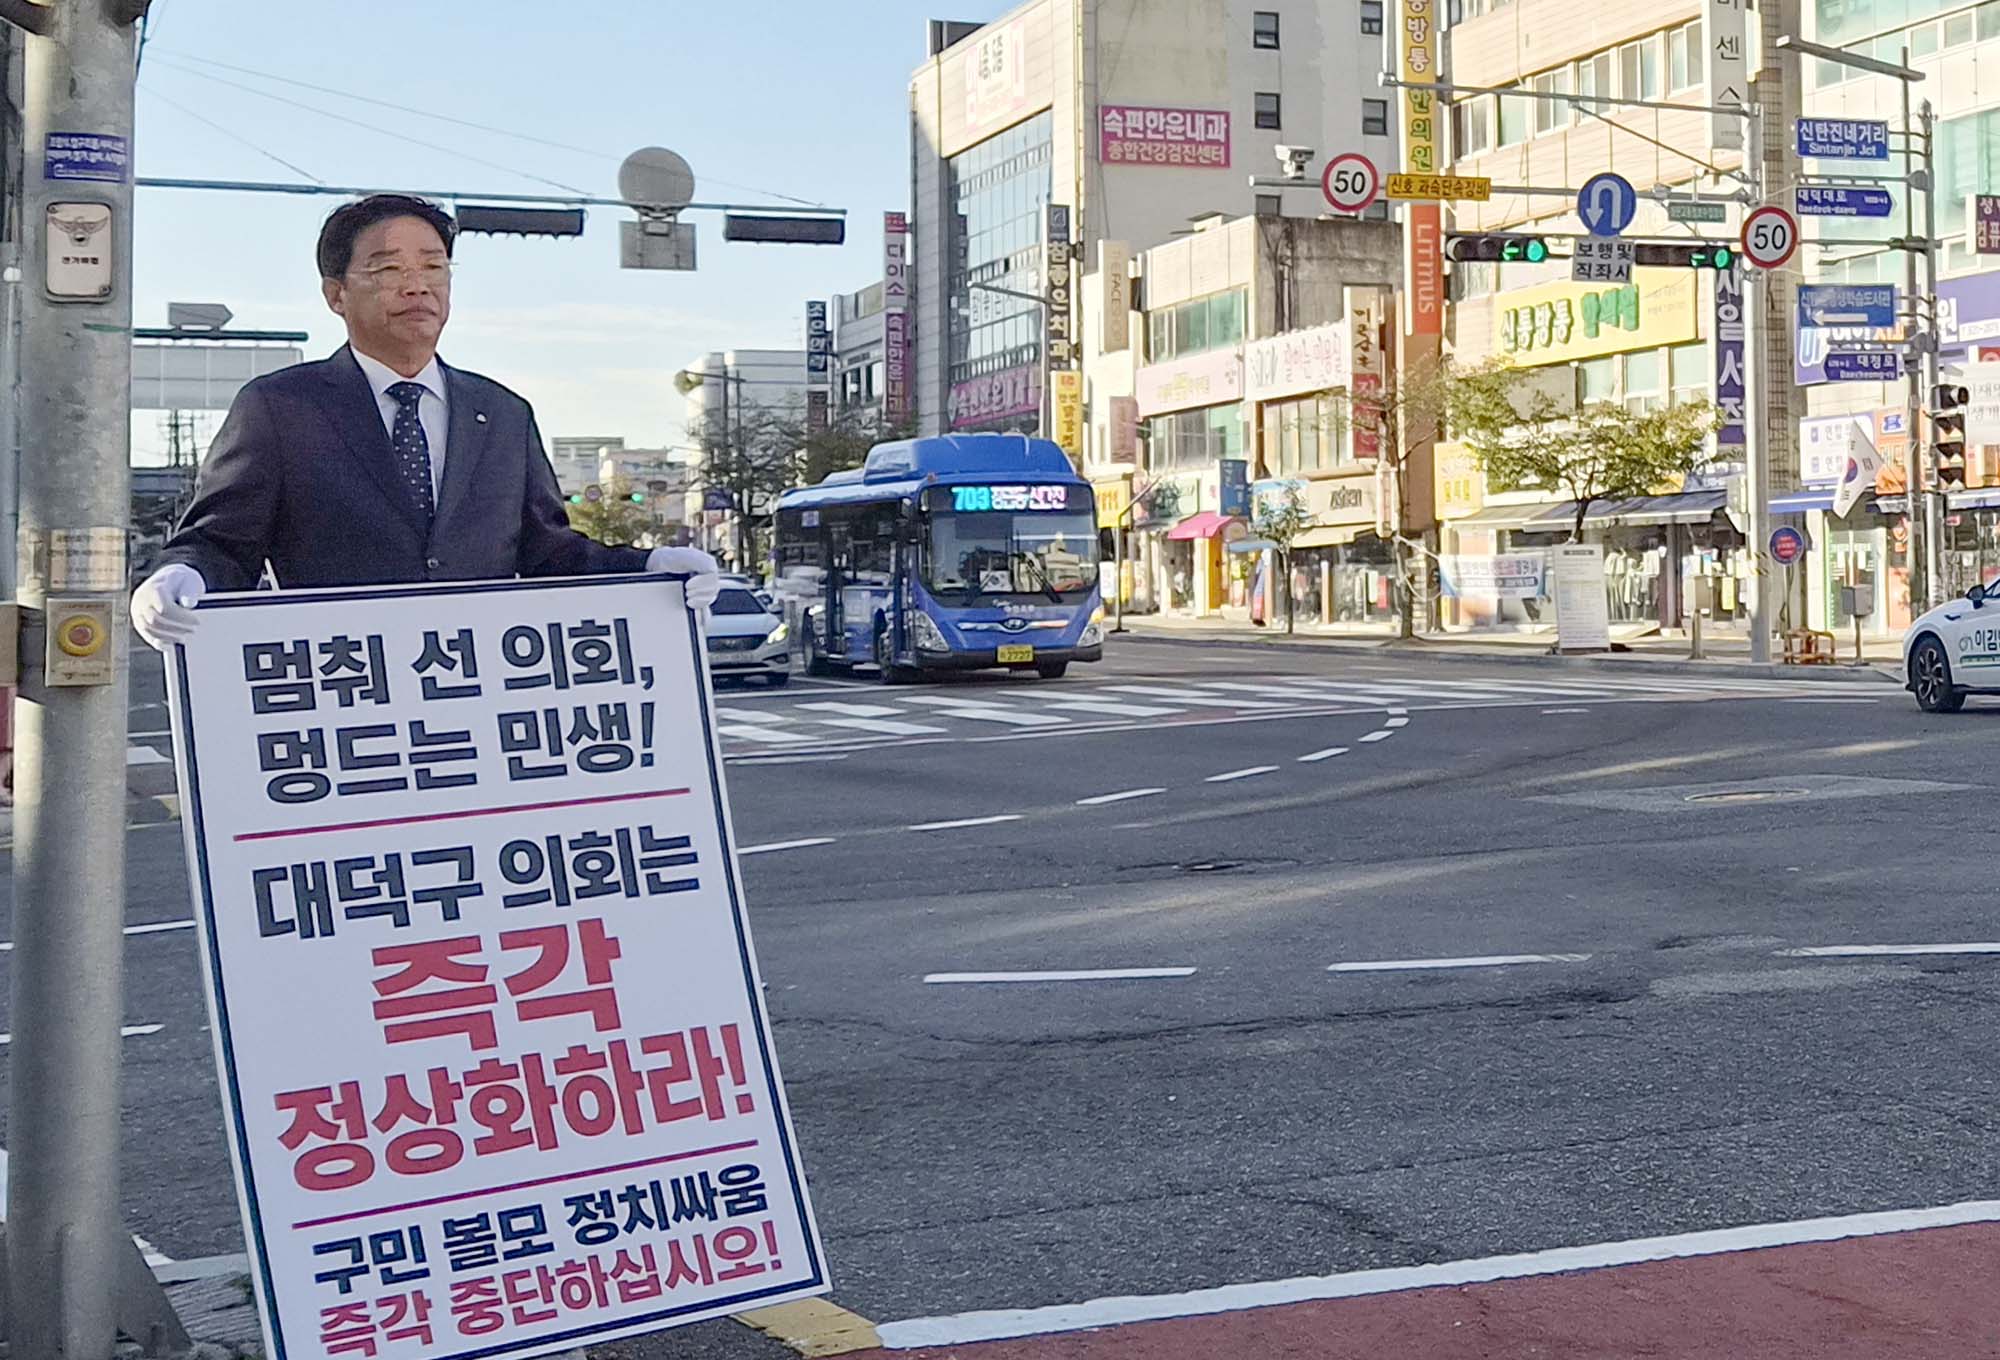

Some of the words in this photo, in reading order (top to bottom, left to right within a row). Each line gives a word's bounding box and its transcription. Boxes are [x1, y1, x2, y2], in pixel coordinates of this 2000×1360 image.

[1104, 109, 1227, 142] 속편한윤내과
[1800, 121, 1885, 144] 신탄진네거리
[1108, 140, 1225, 165] 종합건강검진센터
[1809, 142, 1856, 157] Sintanjin
[1859, 145, 1876, 156] Jct
[1334, 170, 1366, 194] 50
[1391, 177, 1413, 194] 신호
[1798, 189, 1847, 203] 대덕대로
[1754, 223, 1786, 250] 50
[887, 243, 905, 296] 다이소
[1502, 298, 1574, 352] 신통방통
[1857, 354, 1894, 369] 대청로
[951, 486, 990, 511] 703
[243, 634, 391, 715] 멈춰
[412, 628, 482, 700] 선
[501, 618, 654, 690] 의회,
[257, 720, 478, 803] 멍드는
[498, 702, 655, 781] 민생!
[253, 845, 484, 939] 대덕구
[500, 825, 700, 909] 의회는
[371, 917, 622, 1051] 즉각
[275, 1023, 755, 1192] 정상화하라!
[313, 1225, 430, 1295] 구민
[443, 1203, 555, 1271] 볼모
[564, 1162, 769, 1247] 정치싸움
[320, 1290, 433, 1357] 즉각
[450, 1220, 783, 1336] 중단하십시오!
